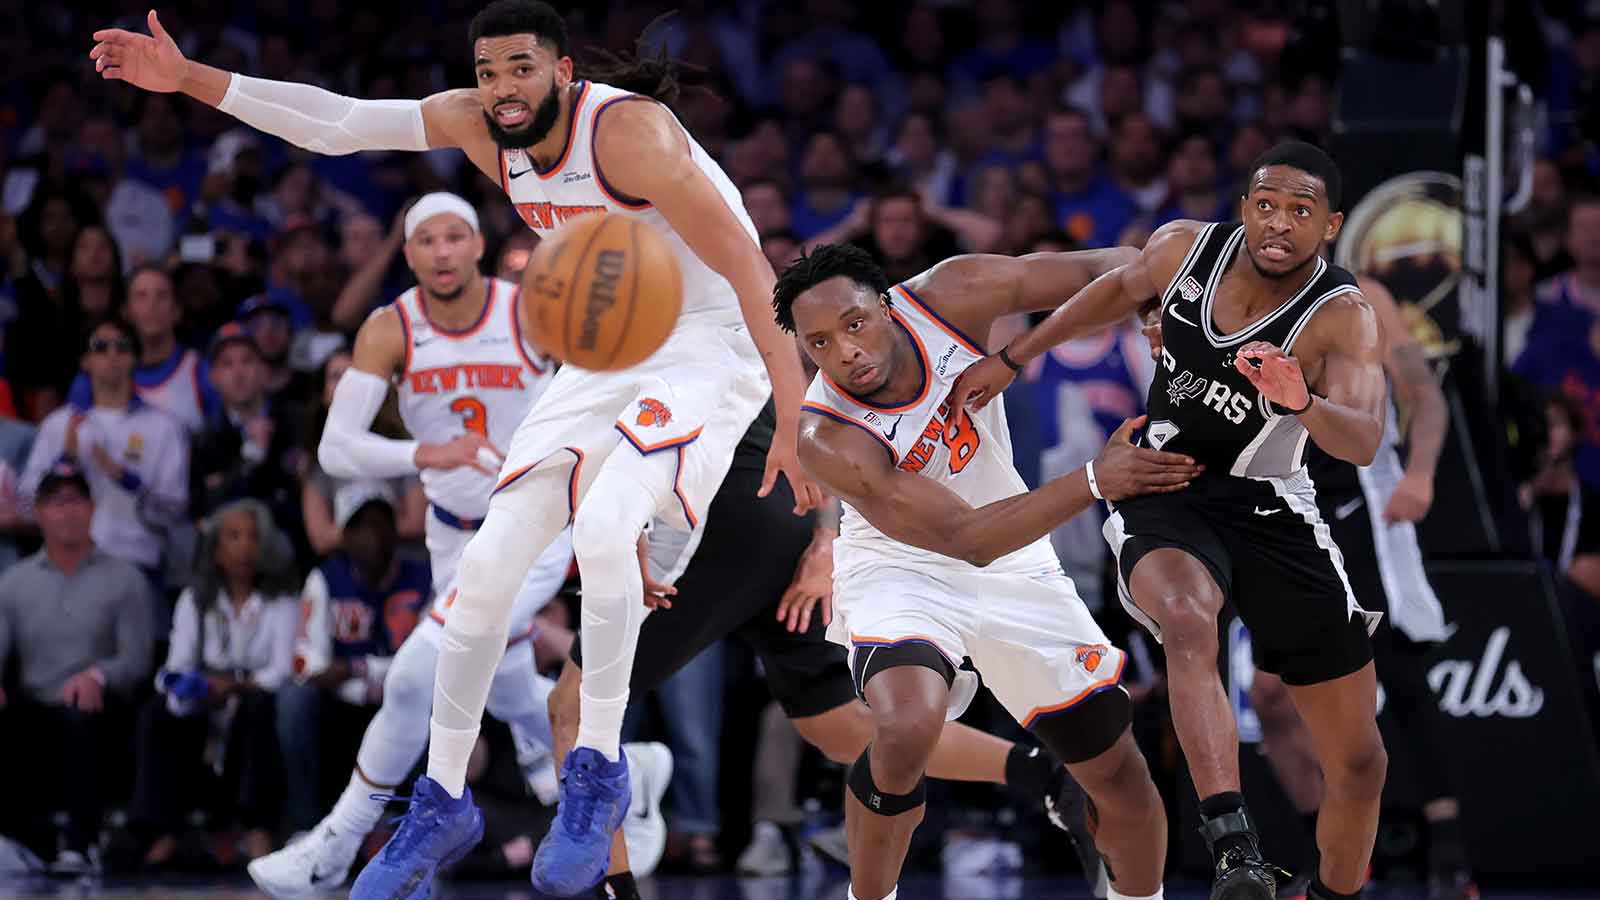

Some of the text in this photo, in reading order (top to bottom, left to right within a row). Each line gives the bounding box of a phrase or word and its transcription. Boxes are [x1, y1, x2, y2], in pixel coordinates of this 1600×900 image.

[410, 364, 525, 393] NEW YORK
[450, 396, 488, 441] 3
[942, 406, 981, 475] 8
[898, 416, 944, 473] NEW
